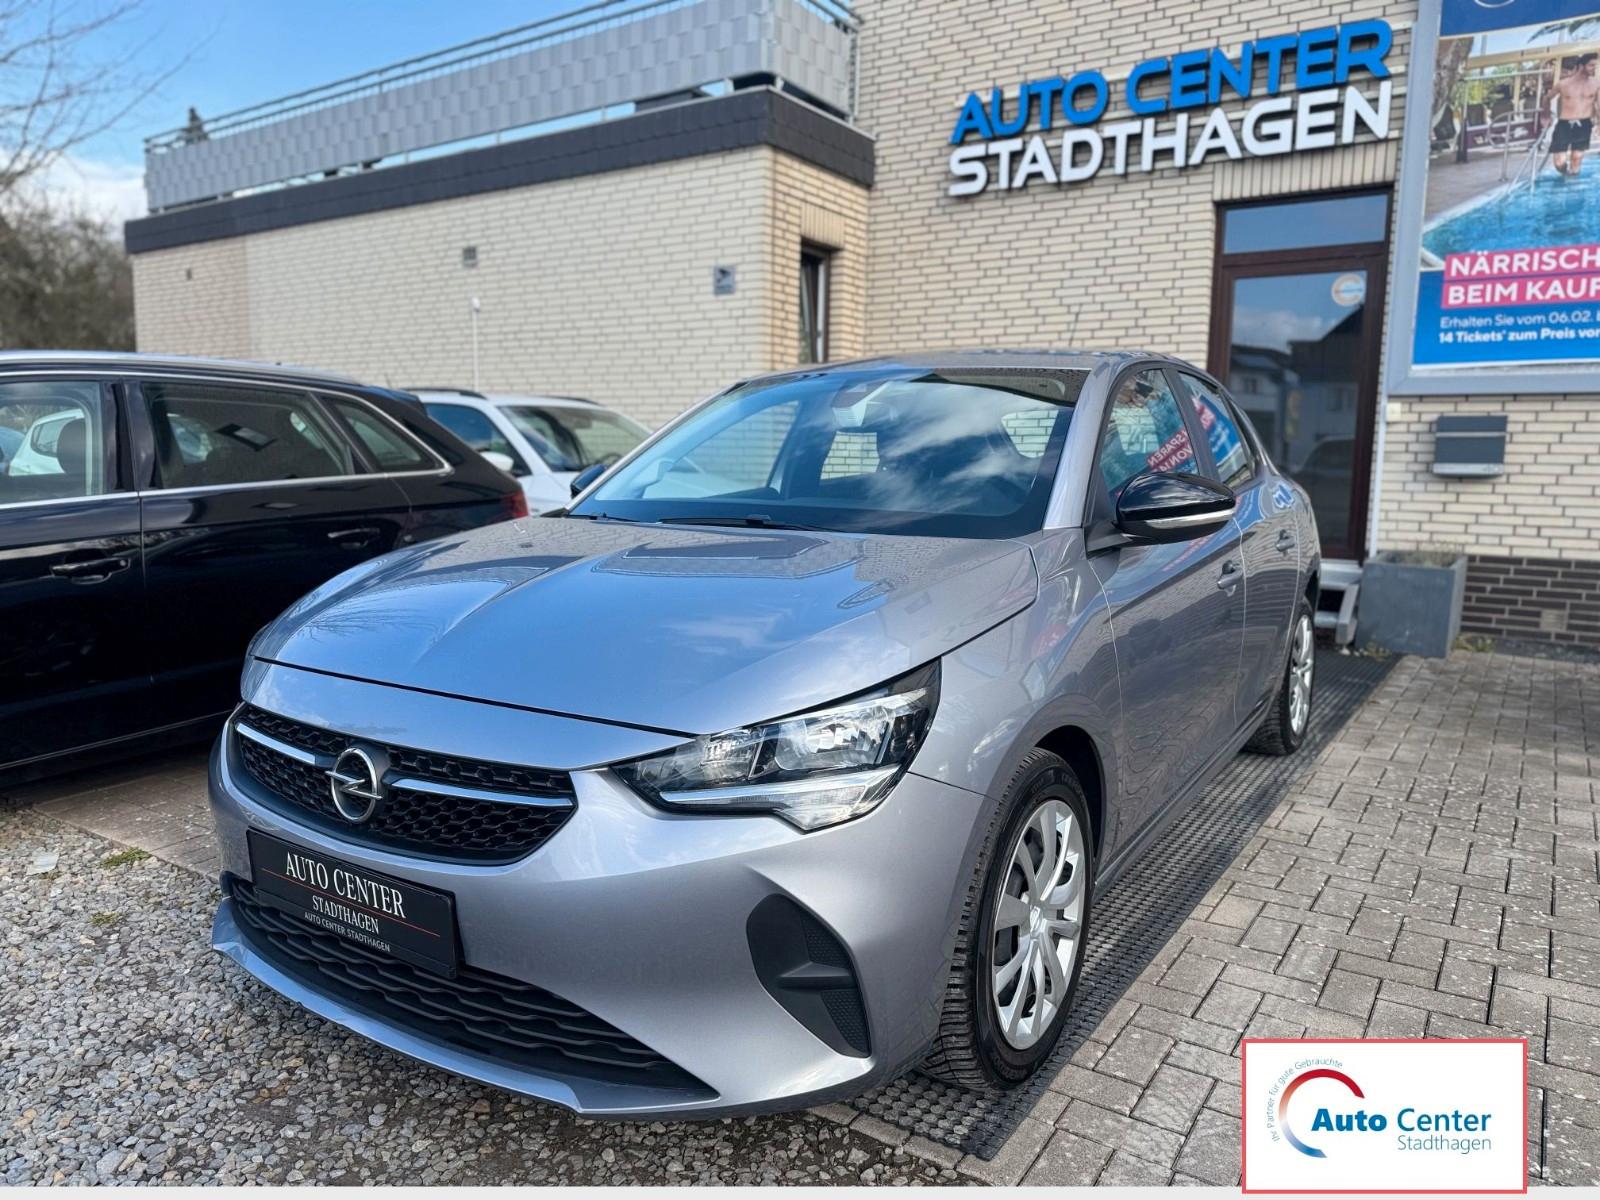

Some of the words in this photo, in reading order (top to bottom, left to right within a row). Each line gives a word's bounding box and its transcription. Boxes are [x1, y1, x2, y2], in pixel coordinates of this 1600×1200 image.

[949, 69, 1109, 145] AUTO
[1126, 18, 1393, 115] CENTER
[948, 80, 1393, 197] STADTHAGEN
[1449, 247, 1600, 278] NÄRRISCH
[1447, 282, 1518, 305] BEIM
[1439, 316, 1493, 328] Erhalten
[1494, 314, 1515, 326] Sie
[1517, 315, 1546, 326] vom
[1548, 310, 1594, 324] 06.02.
[1439, 331, 1454, 344] 14
[1508, 330, 1538, 341] zum
[1540, 326, 1576, 340] Preis
[285, 851, 329, 890] AUTO
[333, 868, 407, 919] CENTER
[304, 912, 321, 926] AUTO
[321, 918, 347, 936] CENTER
[346, 929, 391, 953] STADTHAGEN
[312, 895, 380, 935] STADTHAGEN
